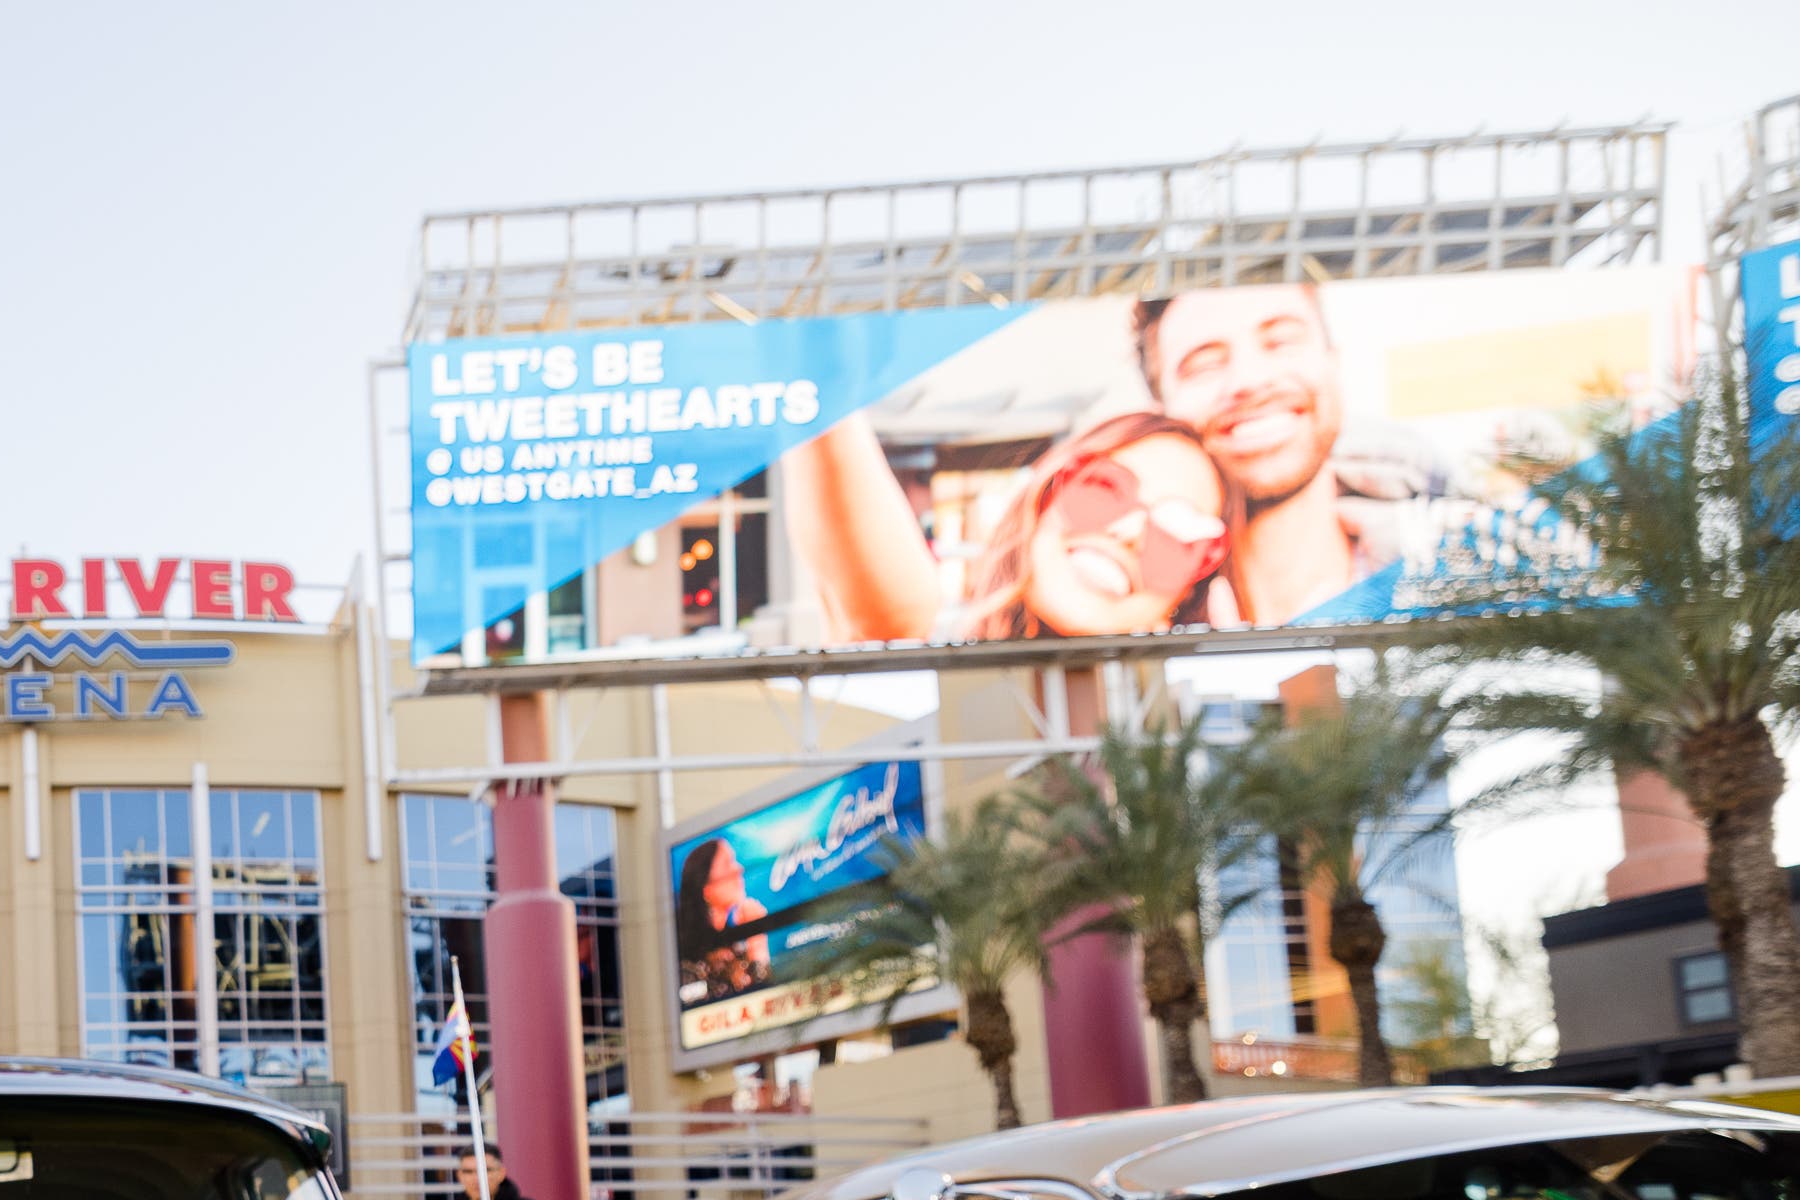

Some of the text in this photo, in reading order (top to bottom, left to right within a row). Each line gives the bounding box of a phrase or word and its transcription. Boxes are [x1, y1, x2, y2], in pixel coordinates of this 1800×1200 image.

[431, 340, 664, 396] LET'S BE
[430, 380, 820, 444] TWEETHEARTS
[460, 445, 504, 474] US
[510, 436, 653, 471] ANYTIME
[10, 558, 303, 624] RIVER
